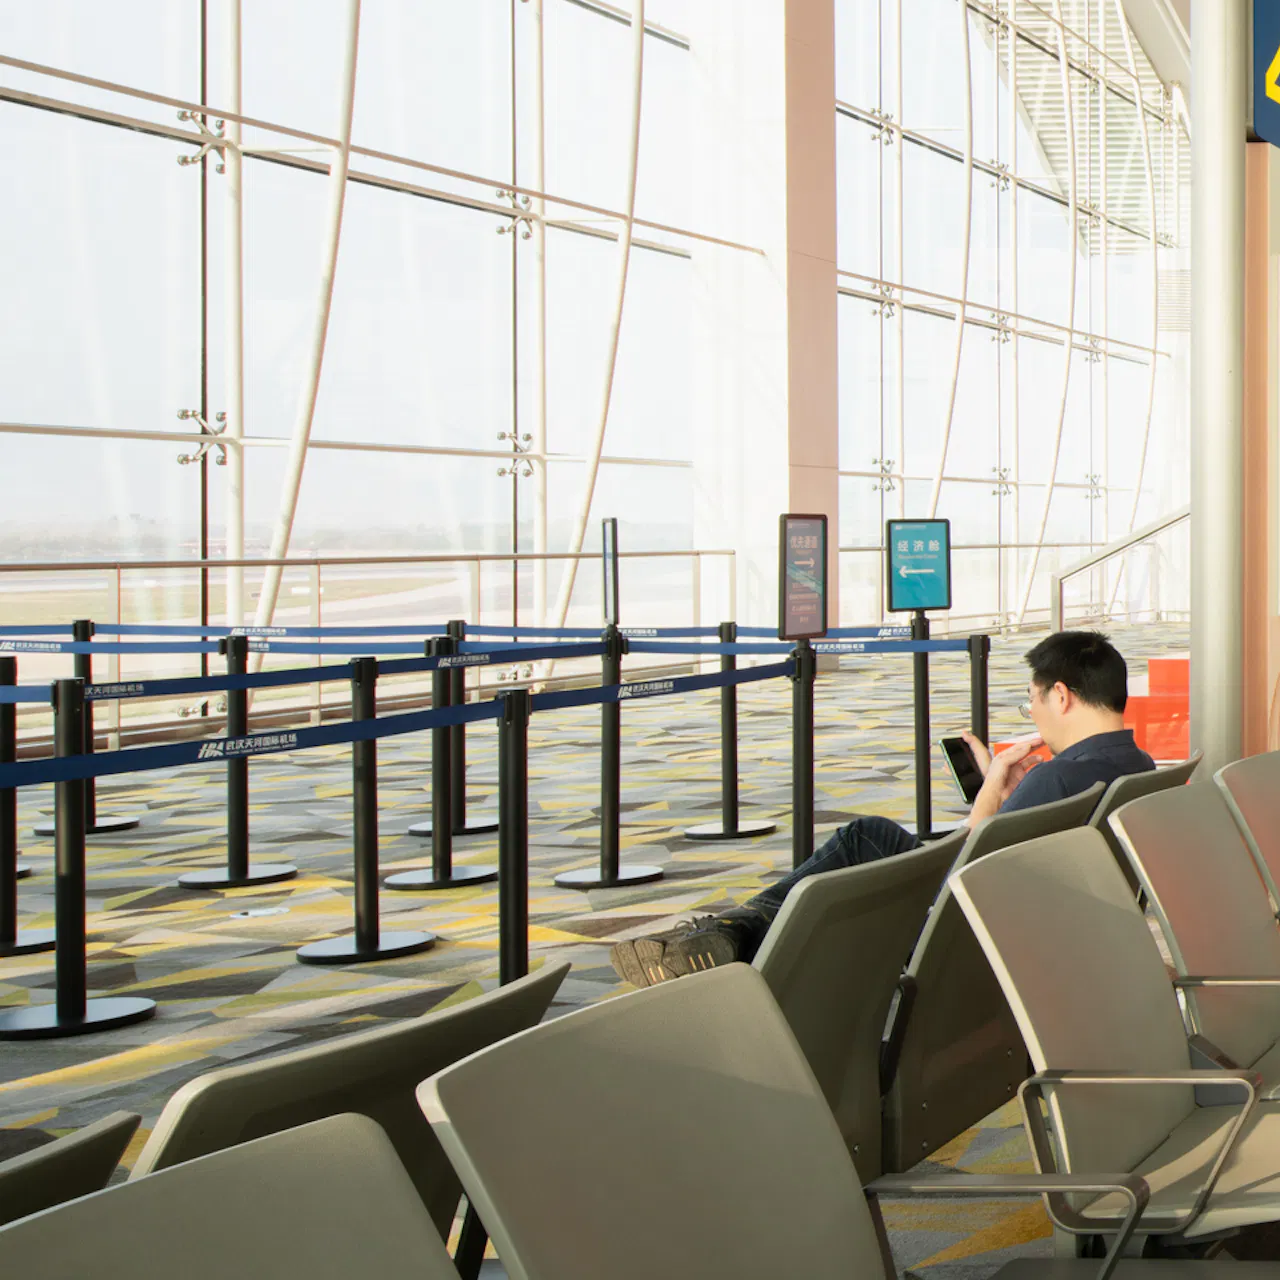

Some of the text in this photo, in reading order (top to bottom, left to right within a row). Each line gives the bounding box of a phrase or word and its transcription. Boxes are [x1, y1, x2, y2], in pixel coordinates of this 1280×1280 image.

[84, 684, 145, 695] 汉天河国际机场
